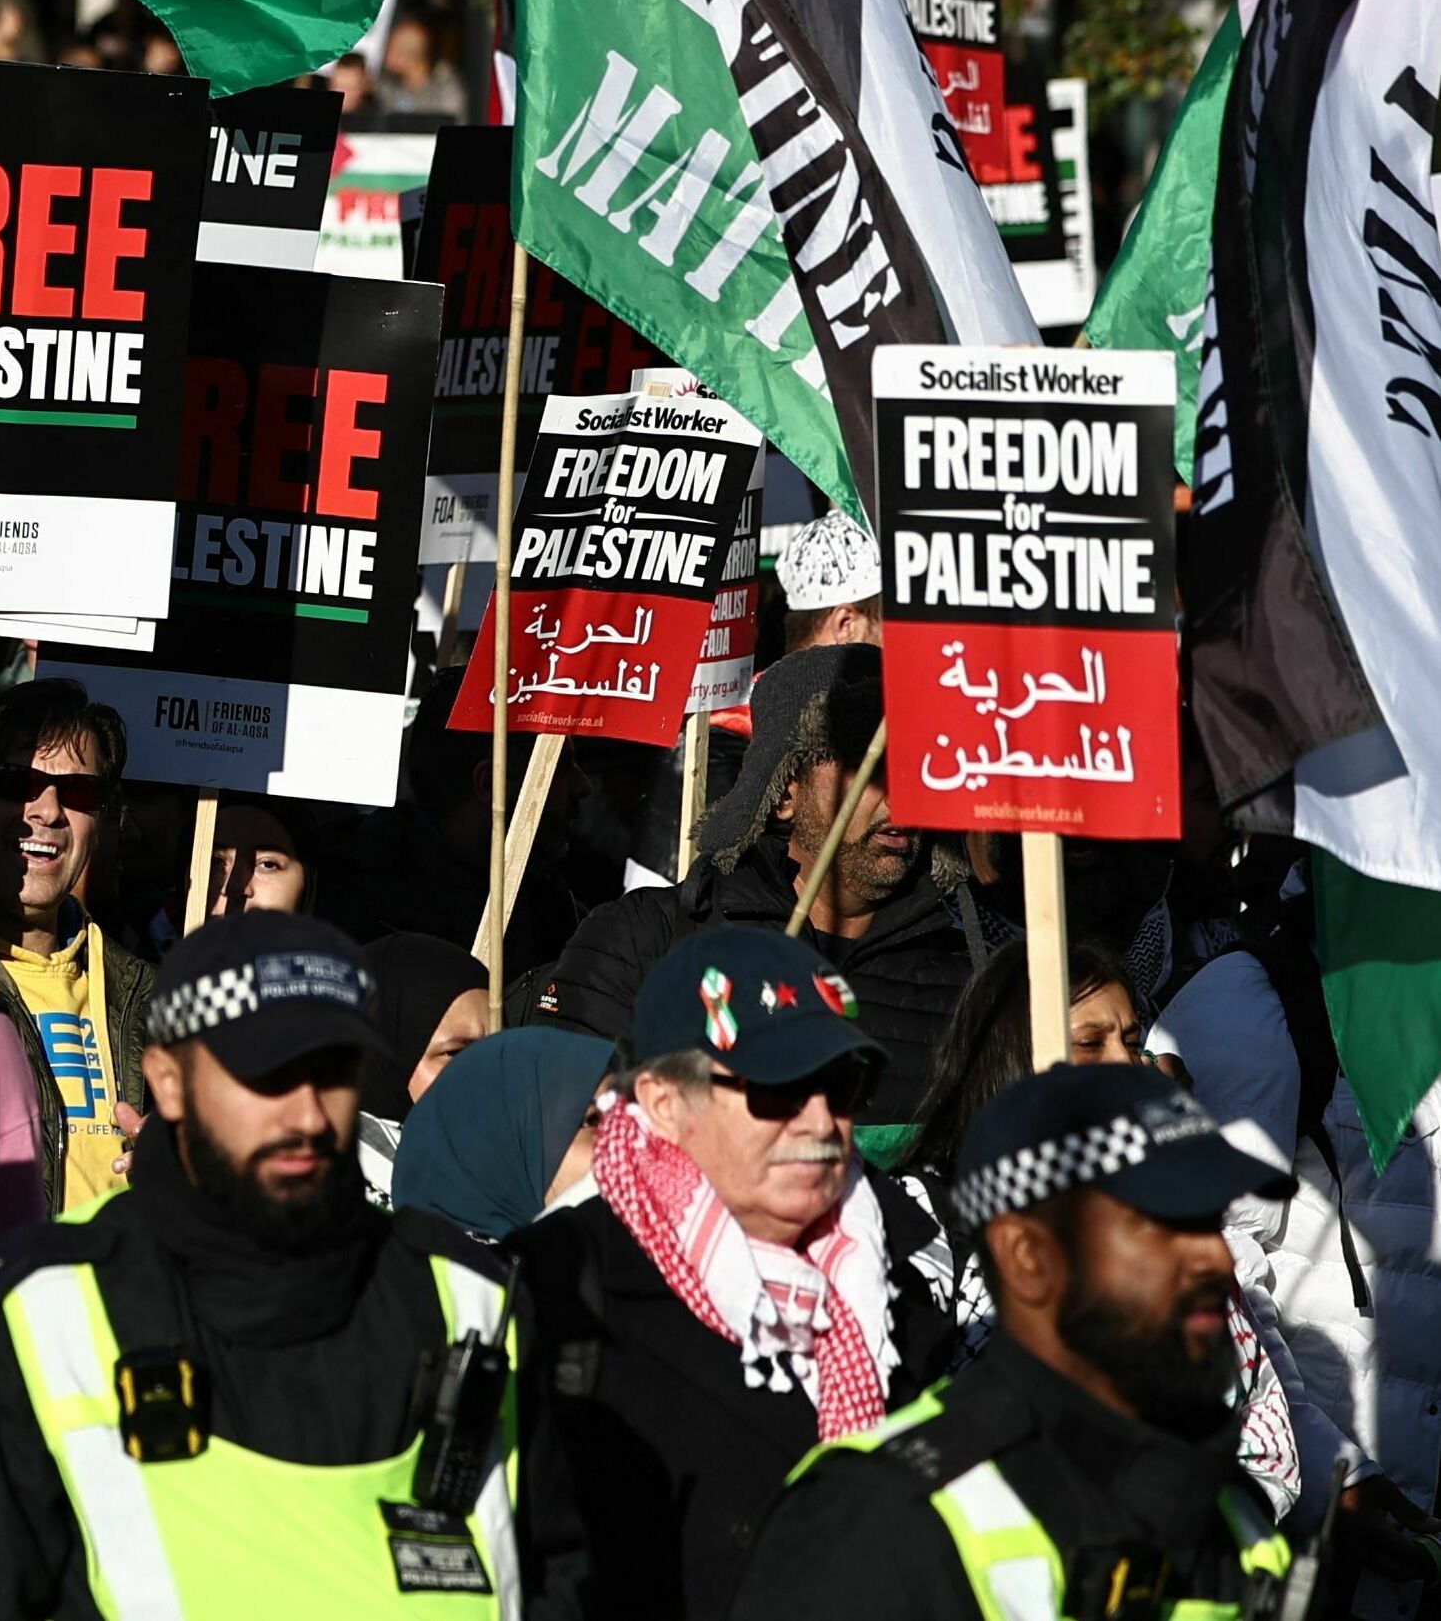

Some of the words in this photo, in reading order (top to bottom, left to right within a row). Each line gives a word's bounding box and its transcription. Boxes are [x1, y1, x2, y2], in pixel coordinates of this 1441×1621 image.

[920, 360, 1028, 396] Socialist
[1033, 363, 1123, 396] Worker
[574, 404, 655, 432] Socialist
[655, 408, 728, 435] Worker
[902, 415, 1138, 497] FREEDOM
[543, 446, 727, 507] FREEDOM
[432, 496, 456, 525] FOA
[603, 498, 637, 526] for
[1002, 493, 1046, 533] for
[510, 524, 716, 588] PALESTINE
[894, 530, 1156, 615] PALESTINE
[523, 602, 654, 655] الحرية
[488, 651, 662, 706] لفلسطين
[938, 640, 1107, 719] الحرية
[155, 695, 200, 733] FOA
[213, 701, 271, 725] FRIENDS
[212, 721, 224, 735] OF
[227, 722, 269, 740] AL-AQSA
[515, 711, 606, 729] socialistworker.co.uk
[921, 717, 1135, 792] لفلسطين
[86, 1124, 110, 1136] LIFE
